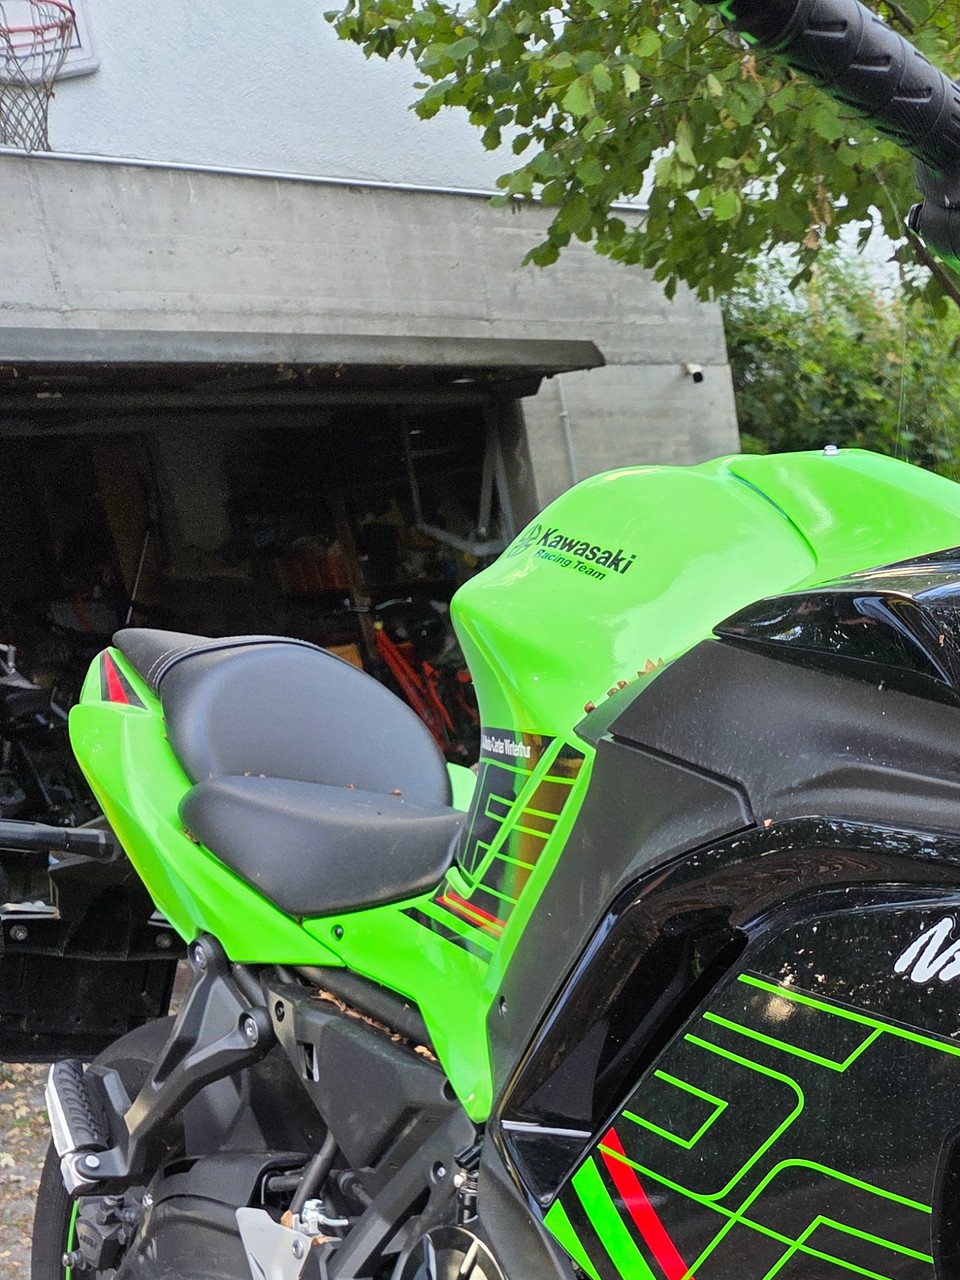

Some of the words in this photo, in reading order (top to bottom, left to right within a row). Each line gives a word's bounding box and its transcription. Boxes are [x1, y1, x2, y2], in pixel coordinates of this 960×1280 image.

[535, 549, 573, 568] Racing
[572, 560, 607, 581] Team
[536, 527, 637, 574] Kawasaki
